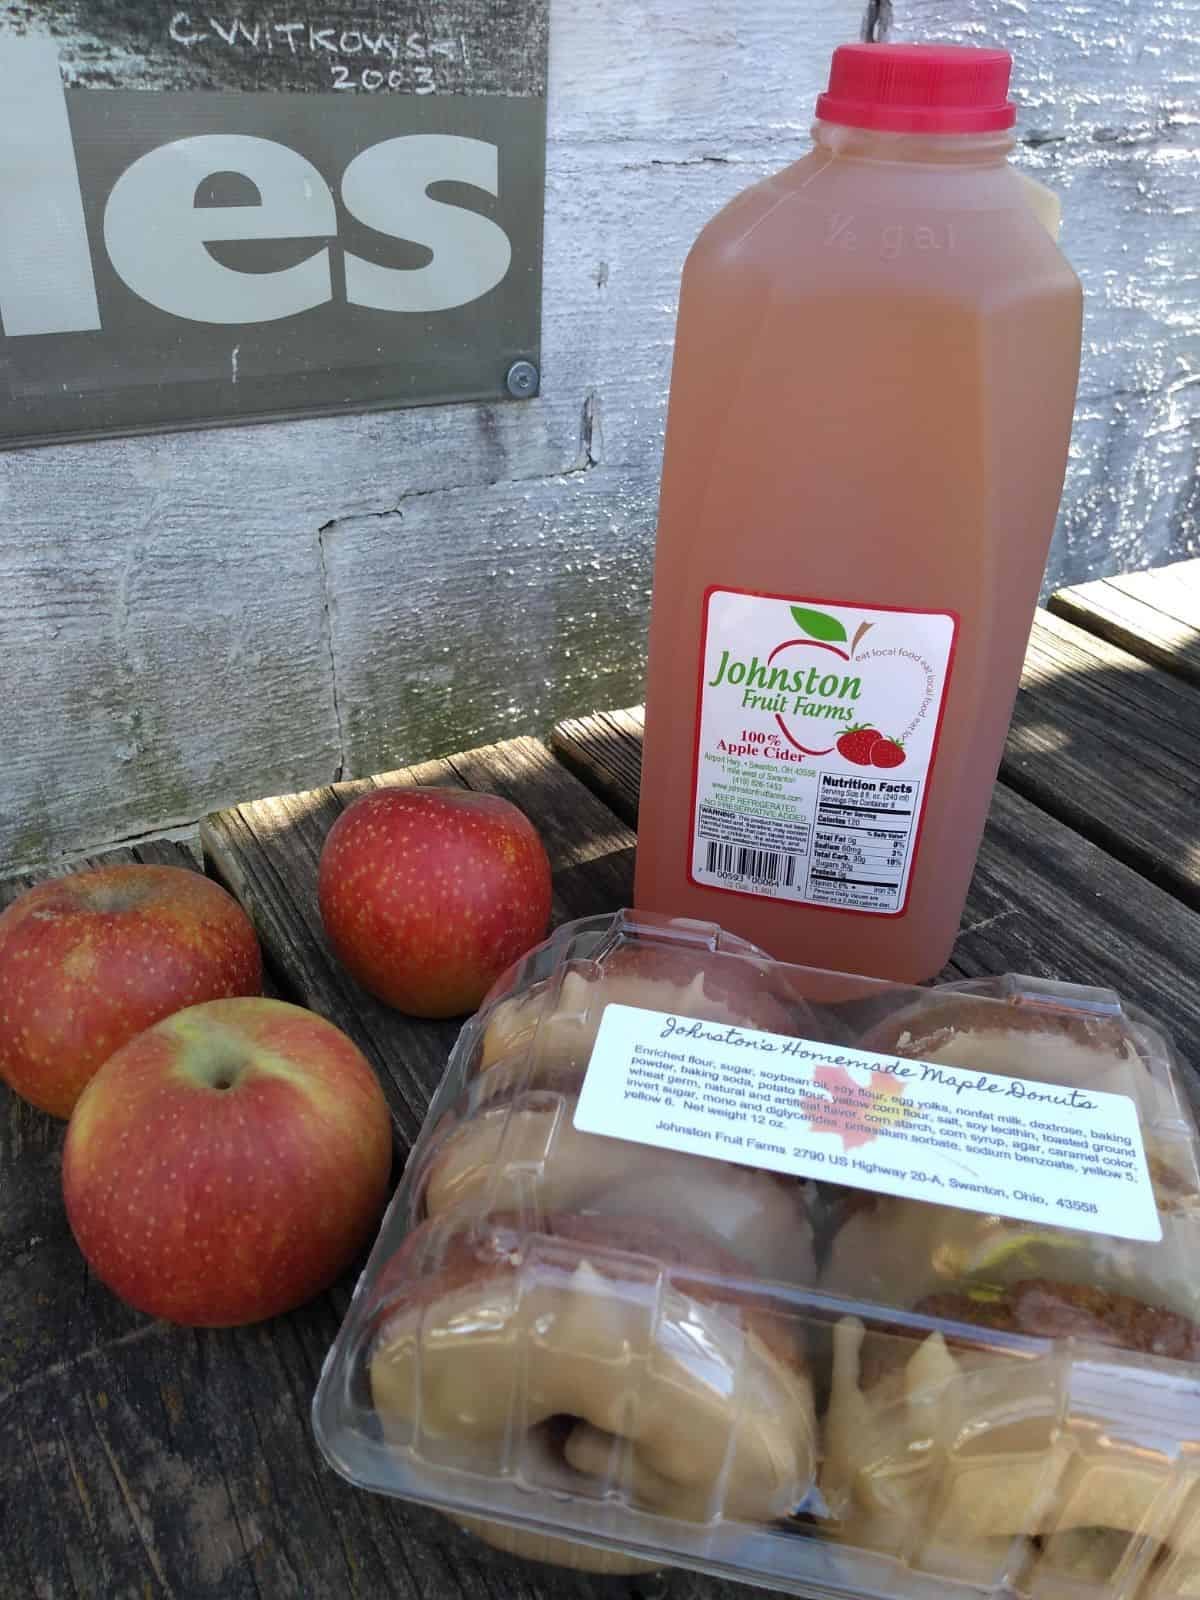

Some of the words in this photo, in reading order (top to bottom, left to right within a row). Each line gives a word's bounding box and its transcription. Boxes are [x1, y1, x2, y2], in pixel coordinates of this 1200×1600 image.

[210, 18, 470, 65] WITKOWSKI
[331, 65, 436, 95] 2003
[709, 651, 862, 700] Johnston
[855, 650, 871, 662] eat
[872, 647, 897, 657] local
[898, 647, 922, 662] food
[926, 674, 936, 696] local
[741, 688, 789, 714] Fruit
[793, 695, 855, 722] Farms
[716, 739, 759, 757] Apple
[763, 746, 806, 763] Cider
[739, 729, 782, 748] 100%
[821, 786, 845, 798] Serving
[845, 789, 859, 798] Size
[822, 775, 877, 792] Nutrition
[879, 782, 913, 794] Facts
[715, 792, 736, 803] KEEP
[736, 796, 797, 812] REFRIGERATED
[820, 795, 847, 805] Servings
[847, 797, 859, 806] Per
[859, 799, 889, 808] Container
[817, 815, 847, 825] Calories
[814, 841, 841, 851] Sodium
[815, 832, 833, 841] Total
[834, 834, 847, 842] Fat
[814, 849, 831, 858] Total
[811, 865, 837, 877] Protein
[660, 1016, 779, 1051] Johnston's
[781, 1041, 917, 1077] Homemade
[920, 1064, 1006, 1096] Maple
[1004, 1081, 1098, 1109] Donuts
[624, 1090, 661, 1103] yellow
[683, 1100, 704, 1112] Net
[708, 1106, 747, 1120] weight
[751, 1114, 766, 1125] 12
[630, 1057, 677, 1073] powder,
[680, 1065, 719, 1082] baking
[722, 1075, 754, 1088] soda,
[758, 1080, 796, 1096] potato
[798, 1088, 827, 1102] flour,
[832, 1095, 870, 1109] yellow
[872, 1101, 900, 1115] corn
[936, 1116, 962, 1128] salt,
[966, 1121, 988, 1133] soy
[991, 1124, 1038, 1142] lecithin,
[1042, 1133, 1089, 1149] toasted
[1092, 1144, 1136, 1159] ground
[634, 1044, 686, 1062] Enriched
[688, 1056, 716, 1070] flour,
[720, 1064, 756, 1077] sugar,
[760, 1071, 809, 1087] soybean
[834, 1086, 853, 1096] soy
[858, 1087, 887, 1102] flour,
[891, 1096, 914, 1108] egg
[917, 1101, 952, 1114] yolks,
[956, 1108, 994, 1121] nonfat
[1029, 1120, 1087, 1141] dextrose,
[1090, 1129, 1133, 1150] baking
[627, 1077, 659, 1095] invert
[662, 1086, 698, 1100] sugar,
[703, 1094, 736, 1106] mono
[739, 1101, 762, 1112] and
[845, 1122, 908, 1141] potassium
[965, 1143, 1011, 1160] sodium
[1014, 1150, 1078, 1172] benzoate,
[1081, 1166, 1122, 1179] yellow
[628, 1068, 664, 1080] wheat
[667, 1075, 701, 1088] germ,
[705, 1081, 745, 1096] natural
[748, 1091, 771, 1102] and
[774, 1095, 820, 1112] artificial
[864, 1112, 890, 1125] corn
[894, 1120, 936, 1135] starch,
[939, 1128, 967, 1139] corn
[970, 1131, 1008, 1148] syrup,
[1012, 1141, 1045, 1154] agar,
[1048, 1148, 1101, 1167] caramel
[656, 1120, 711, 1139] Johnston
[715, 1131, 743, 1146] Fruit
[793, 1147, 825, 1162] 2790
[829, 1154, 848, 1167] US
[852, 1160, 907, 1179] Highway
[910, 1170, 944, 1187] 20-A,
[949, 1178, 1009, 1199] Swanton,
[1013, 1190, 1048, 1206] Ohio,
[1056, 1198, 1098, 1214] 43558
